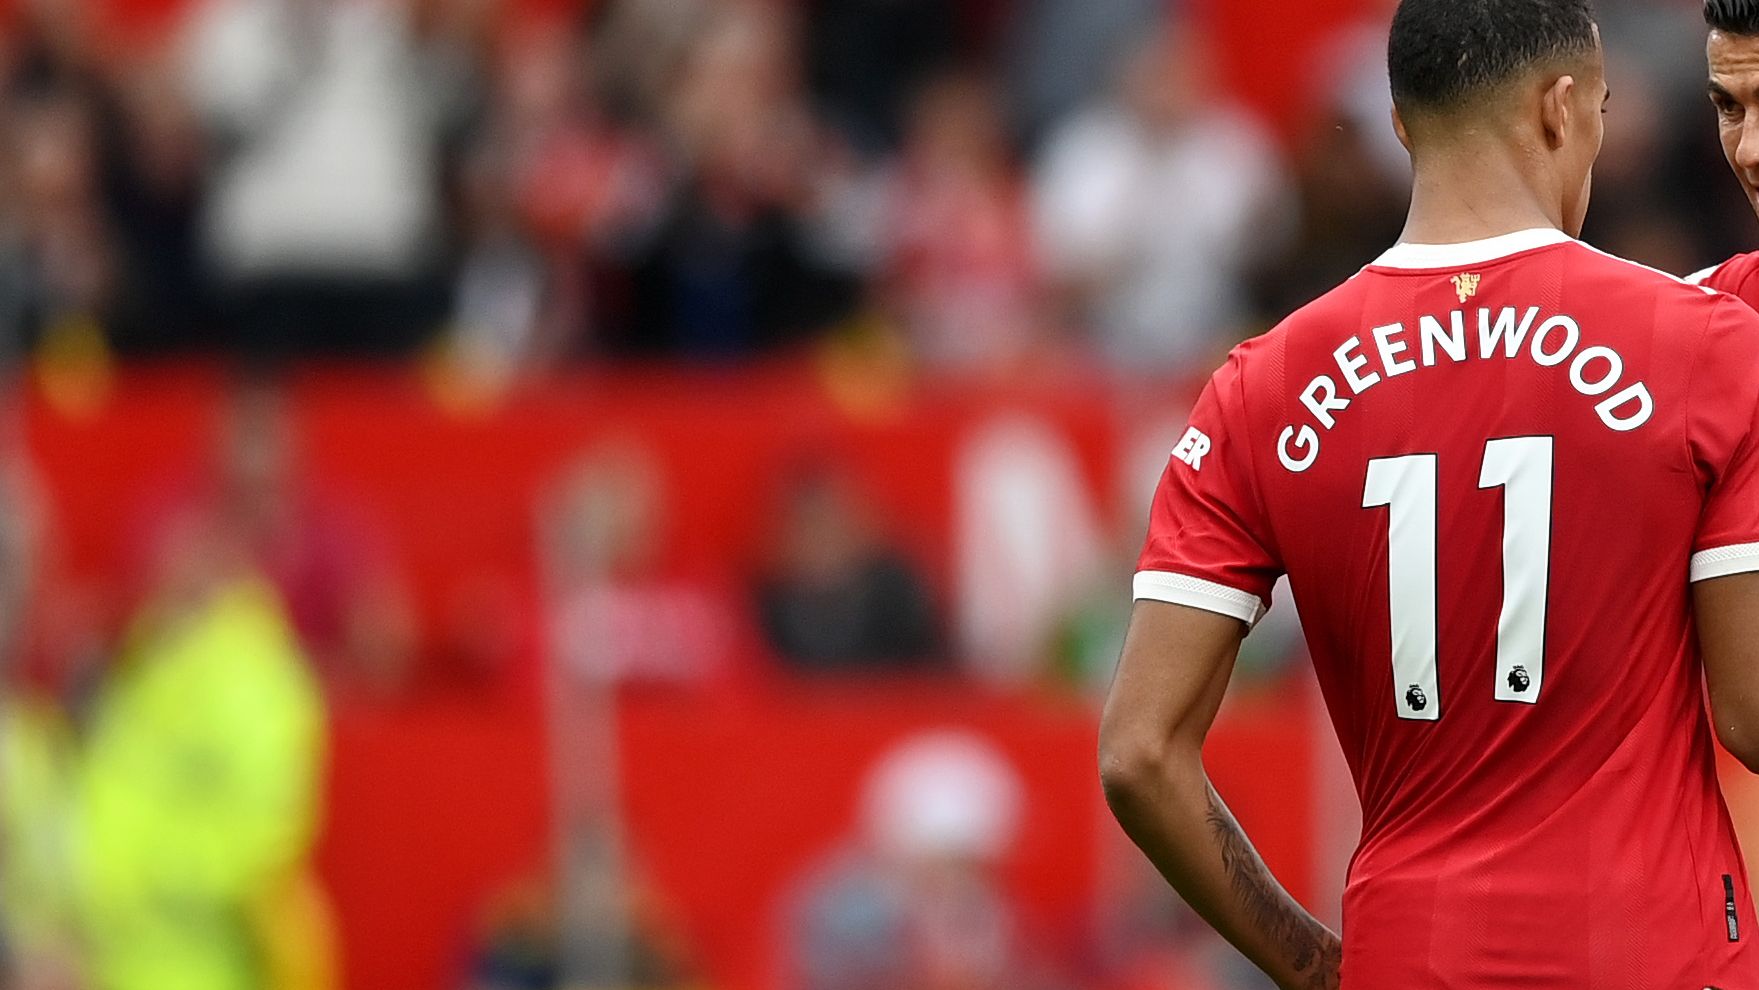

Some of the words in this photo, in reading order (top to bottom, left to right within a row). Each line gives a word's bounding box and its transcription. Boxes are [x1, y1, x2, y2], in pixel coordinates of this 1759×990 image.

[1171, 425, 1212, 471] ER
[1276, 305, 1655, 473] GREENWOOD
[1361, 434, 1554, 722] 11
